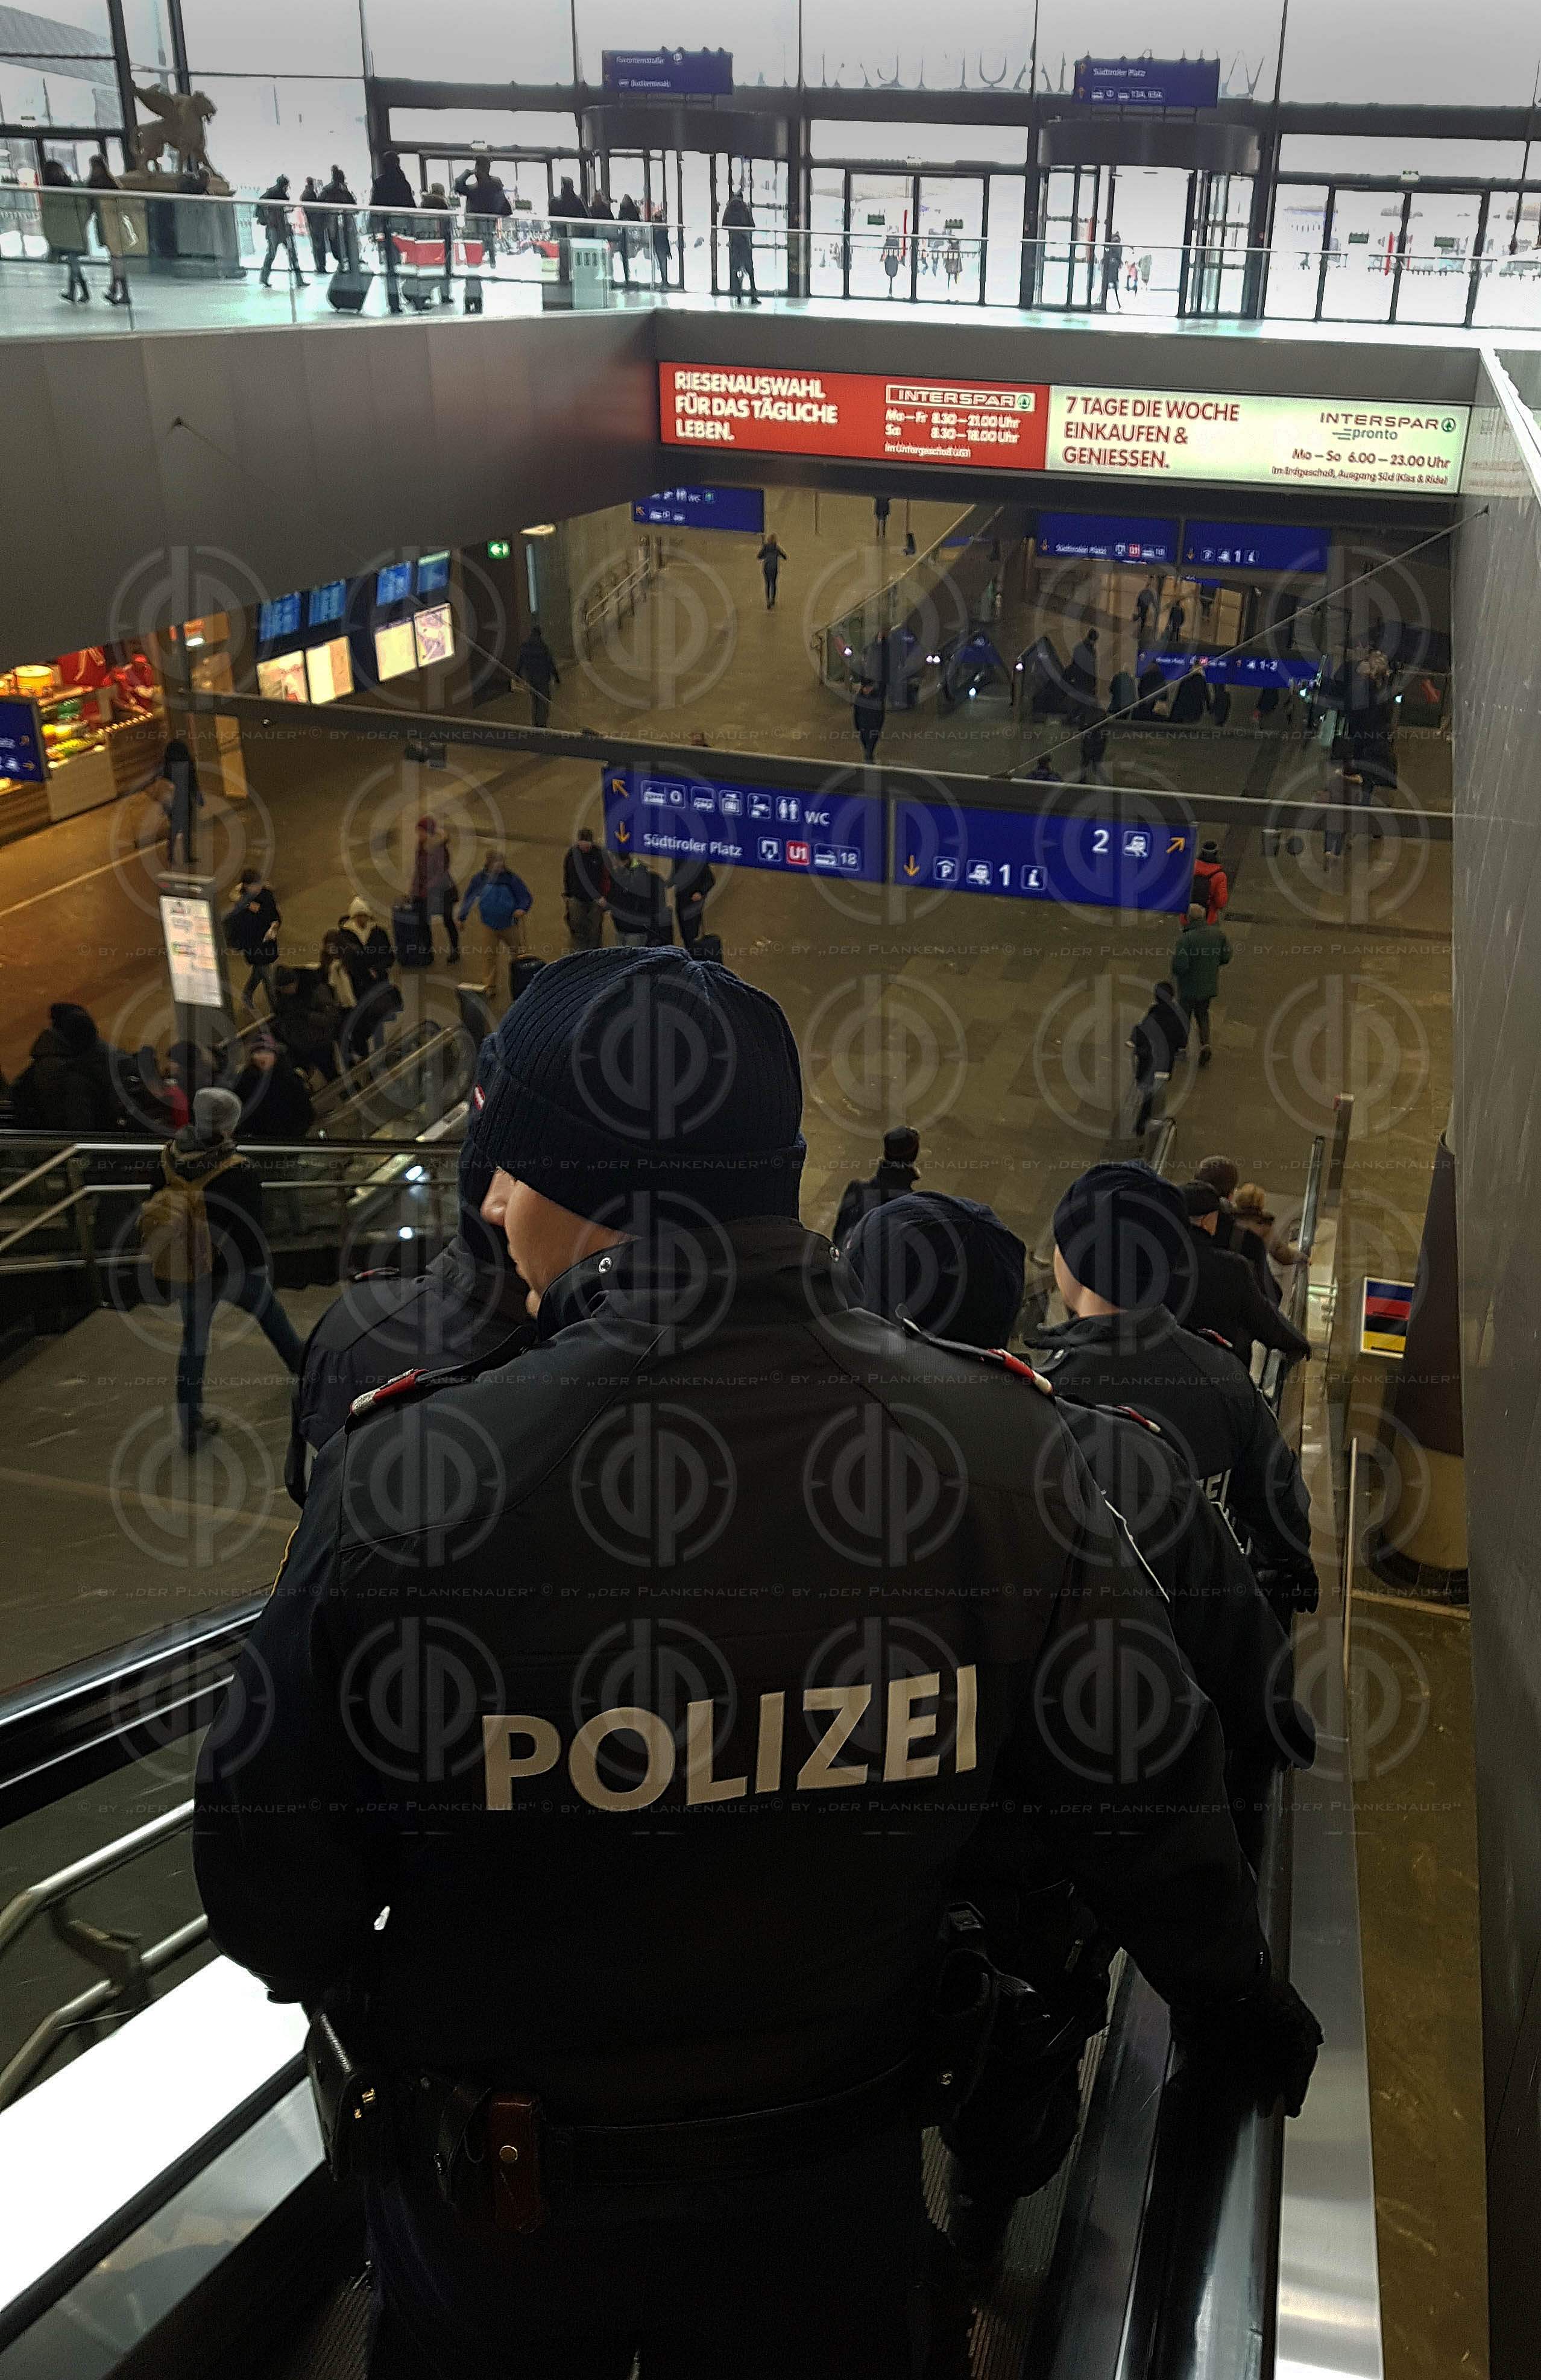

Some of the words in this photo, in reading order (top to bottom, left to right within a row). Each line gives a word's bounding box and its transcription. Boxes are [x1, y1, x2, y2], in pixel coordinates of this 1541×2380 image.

[675, 371, 826, 398] RIESENAUSWAHL
[675, 392, 711, 415] FÜR
[712, 397, 749, 417] DAS
[751, 397, 838, 424] TÄGLICHE
[898, 389, 1014, 406] INTERSPAR
[1066, 396, 1078, 414] 7
[1081, 397, 1128, 417] TAGE
[1132, 399, 1162, 418] DIE
[1166, 400, 1240, 421] WOCHE
[676, 418, 734, 440] LEBEN.
[998, 415, 1021, 429] Uhr
[1320, 412, 1439, 429] INTERSPAR
[998, 429, 1020, 443] Uhr
[1065, 421, 1170, 444] EINKAUFEN
[1174, 427, 1188, 444] &
[1352, 428, 1398, 441] pronto
[1064, 446, 1170, 468] GENIESSEN.
[1292, 449, 1312, 460] Mo
[1326, 450, 1341, 462] So
[1348, 452, 1376, 464] 6.00
[1390, 453, 1425, 467] 23.00
[1427, 455, 1451, 469] Uhr
[805, 810, 830, 826] WC
[643, 832, 706, 853] Südtiroler
[710, 841, 743, 858] Platz
[789, 845, 807, 860] U1
[841, 851, 857, 866] 18
[1092, 829, 1109, 854] 2
[1000, 864, 1011, 887] 1
[482, 1664, 977, 1811] POLIZEI
